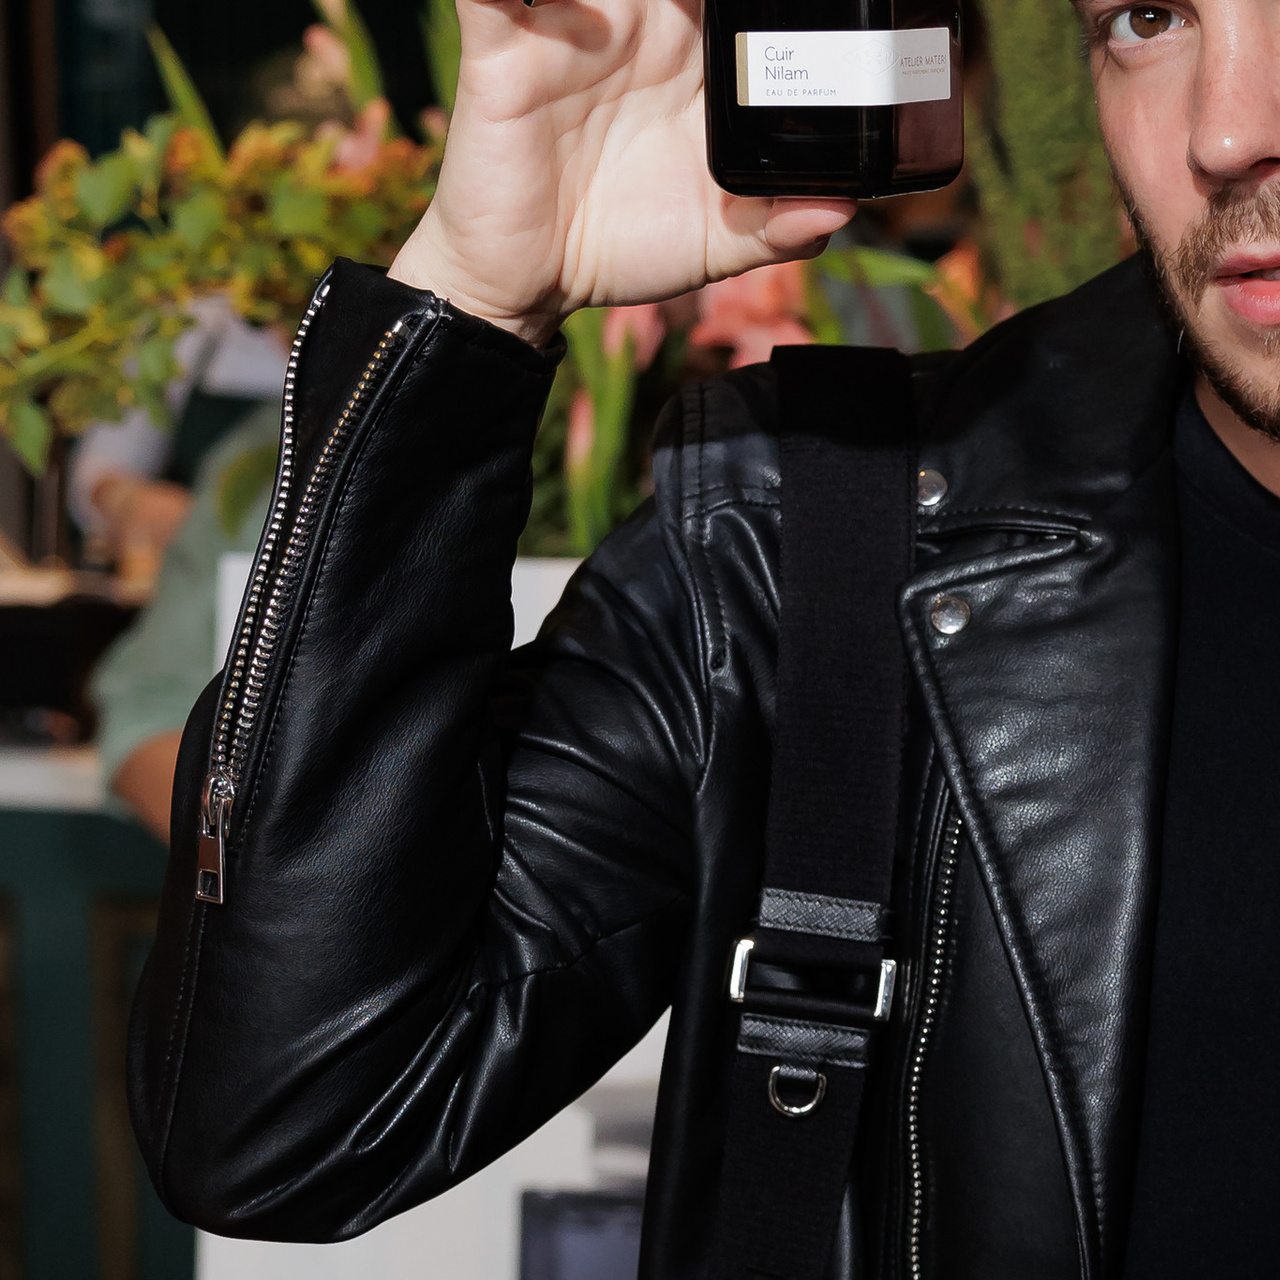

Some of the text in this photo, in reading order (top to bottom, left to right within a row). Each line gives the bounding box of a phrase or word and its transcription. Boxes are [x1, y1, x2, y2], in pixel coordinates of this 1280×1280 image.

[764, 46, 794, 61] Cuir
[900, 55, 924, 67] ATELIER
[765, 66, 809, 81] Nilam
[766, 88, 837, 97] EAU DE PARFUM
